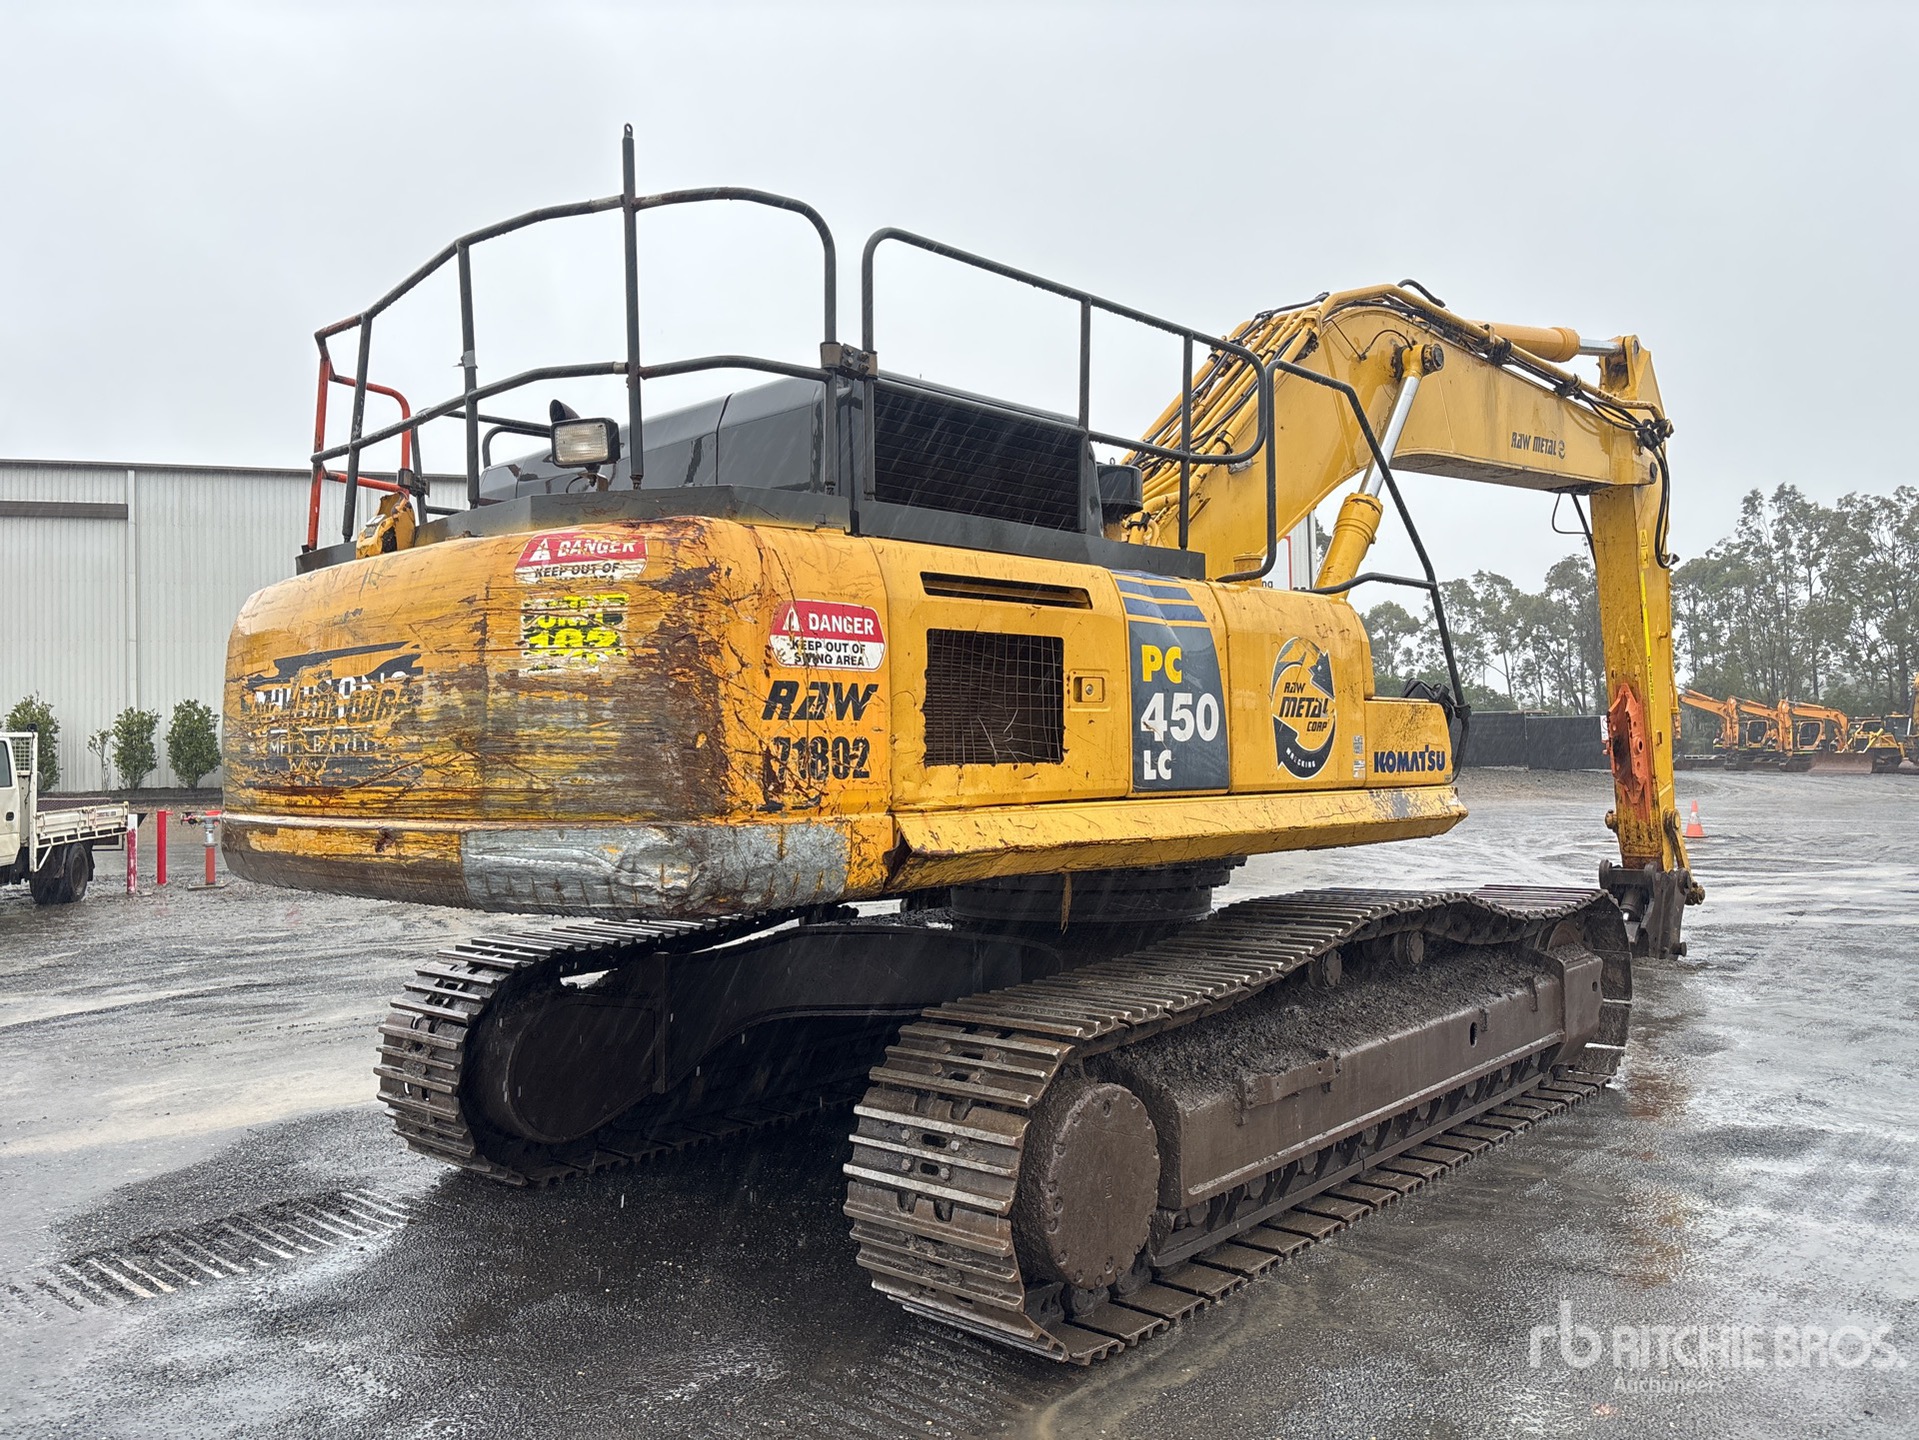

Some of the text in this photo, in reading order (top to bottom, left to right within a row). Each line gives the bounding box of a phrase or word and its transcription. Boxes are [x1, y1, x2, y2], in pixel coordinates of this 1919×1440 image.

[557, 539, 637, 557] DANGER
[535, 562, 621, 578] KEEP OUT OF
[808, 613, 875, 635] DANGER
[790, 639, 866, 654] KEEP OUT OF
[835, 654, 865, 667] AREA
[1141, 644, 1182, 684] PC
[1140, 692, 1219, 742] 450
[1307, 721, 1328, 732] CORP
[772, 736, 870, 780] 71802
[1143, 750, 1172, 780] LC
[1374, 744, 1446, 773] KOMATSU
